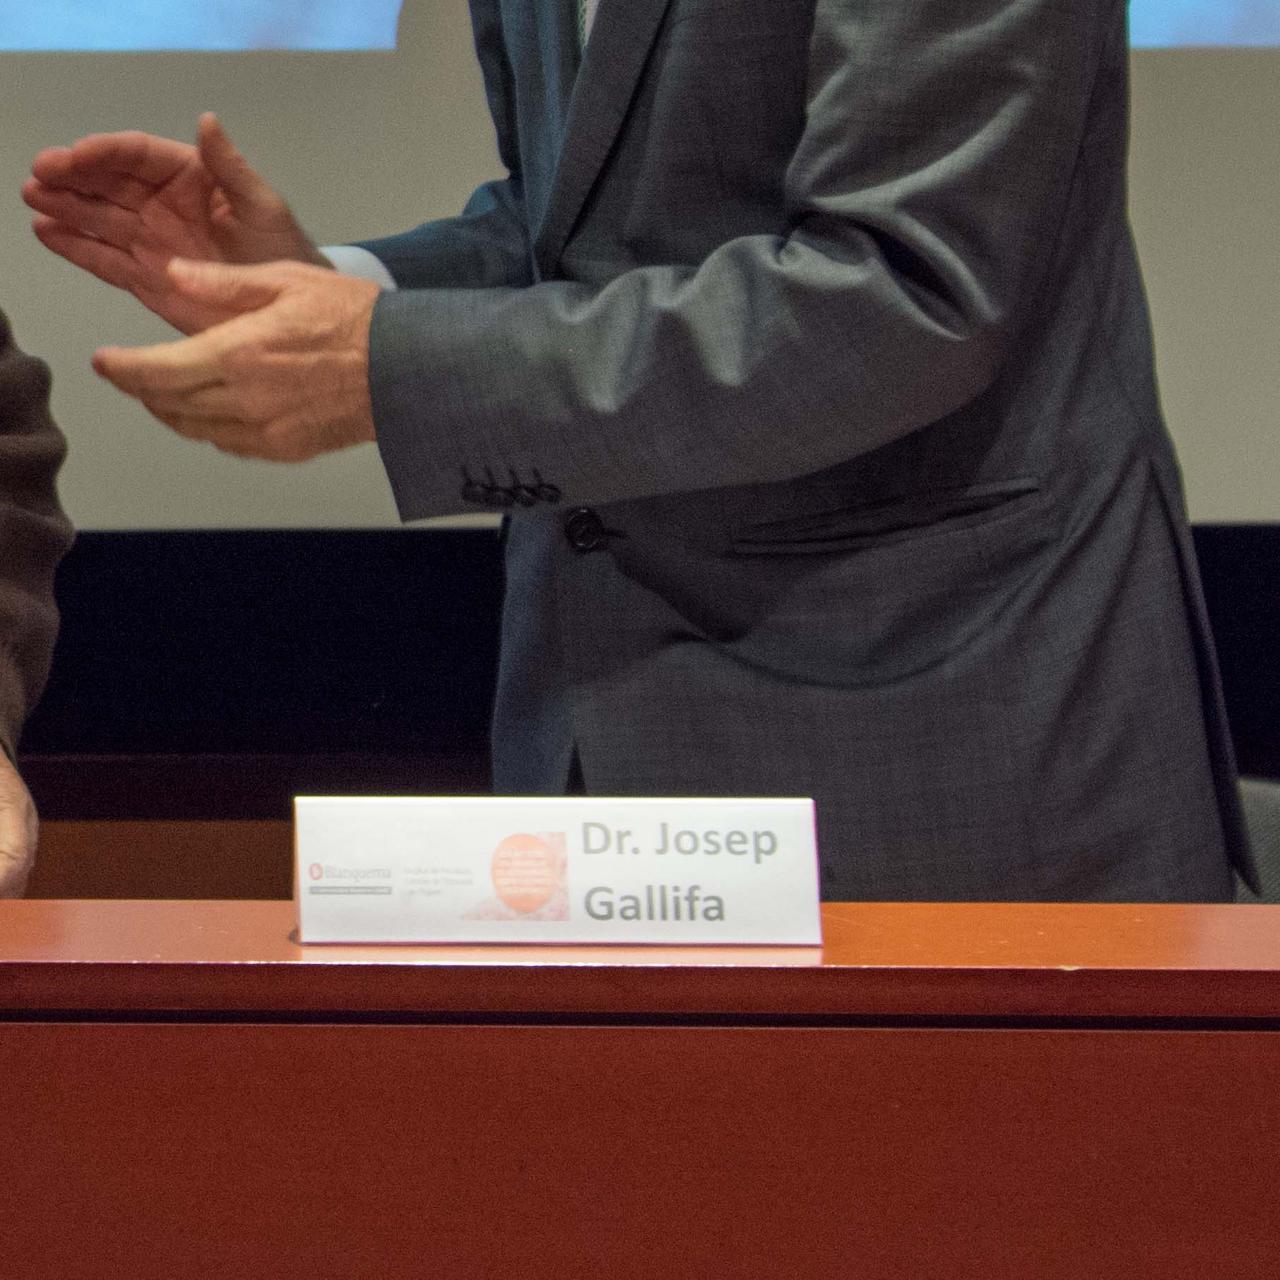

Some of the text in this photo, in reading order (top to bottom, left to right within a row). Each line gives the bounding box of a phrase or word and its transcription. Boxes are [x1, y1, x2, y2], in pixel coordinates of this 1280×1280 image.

[581, 820, 778, 863] Dr. Josep
[584, 884, 726, 922] Gallifa
